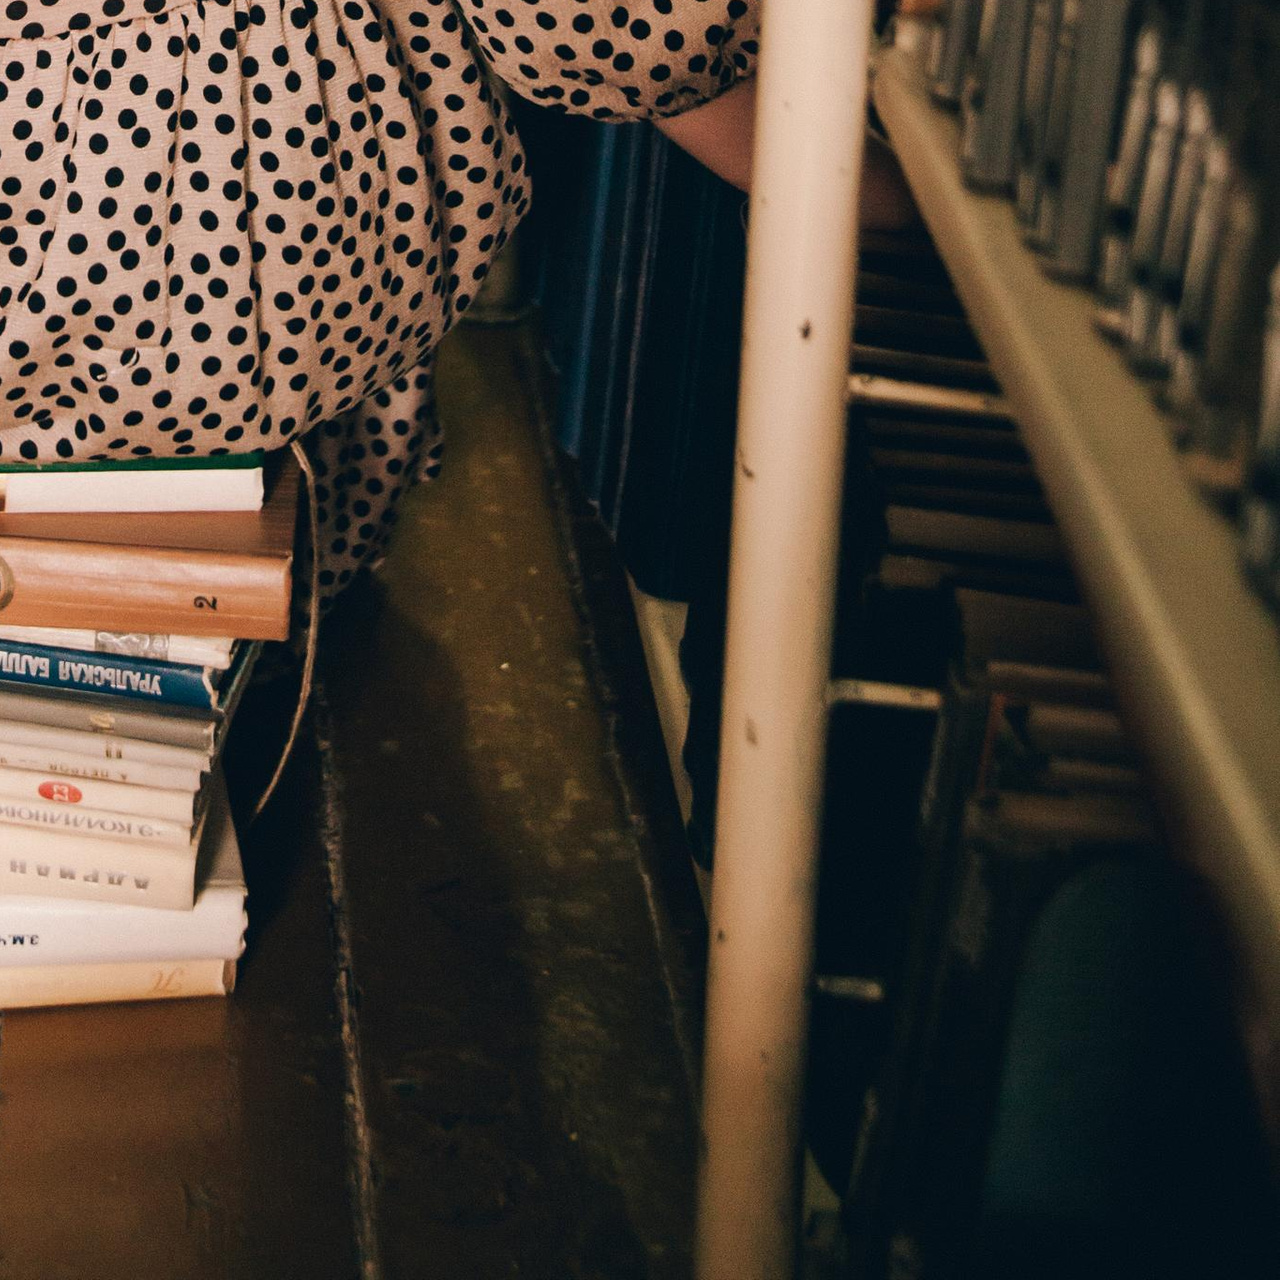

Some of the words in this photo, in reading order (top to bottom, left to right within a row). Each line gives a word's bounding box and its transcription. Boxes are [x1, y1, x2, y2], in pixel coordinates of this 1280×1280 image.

[192, 594, 218, 611] 2
[58, 657, 163, 697] УРАЛЬСКАЯ
[8, 858, 151, 892] АДРИАН
